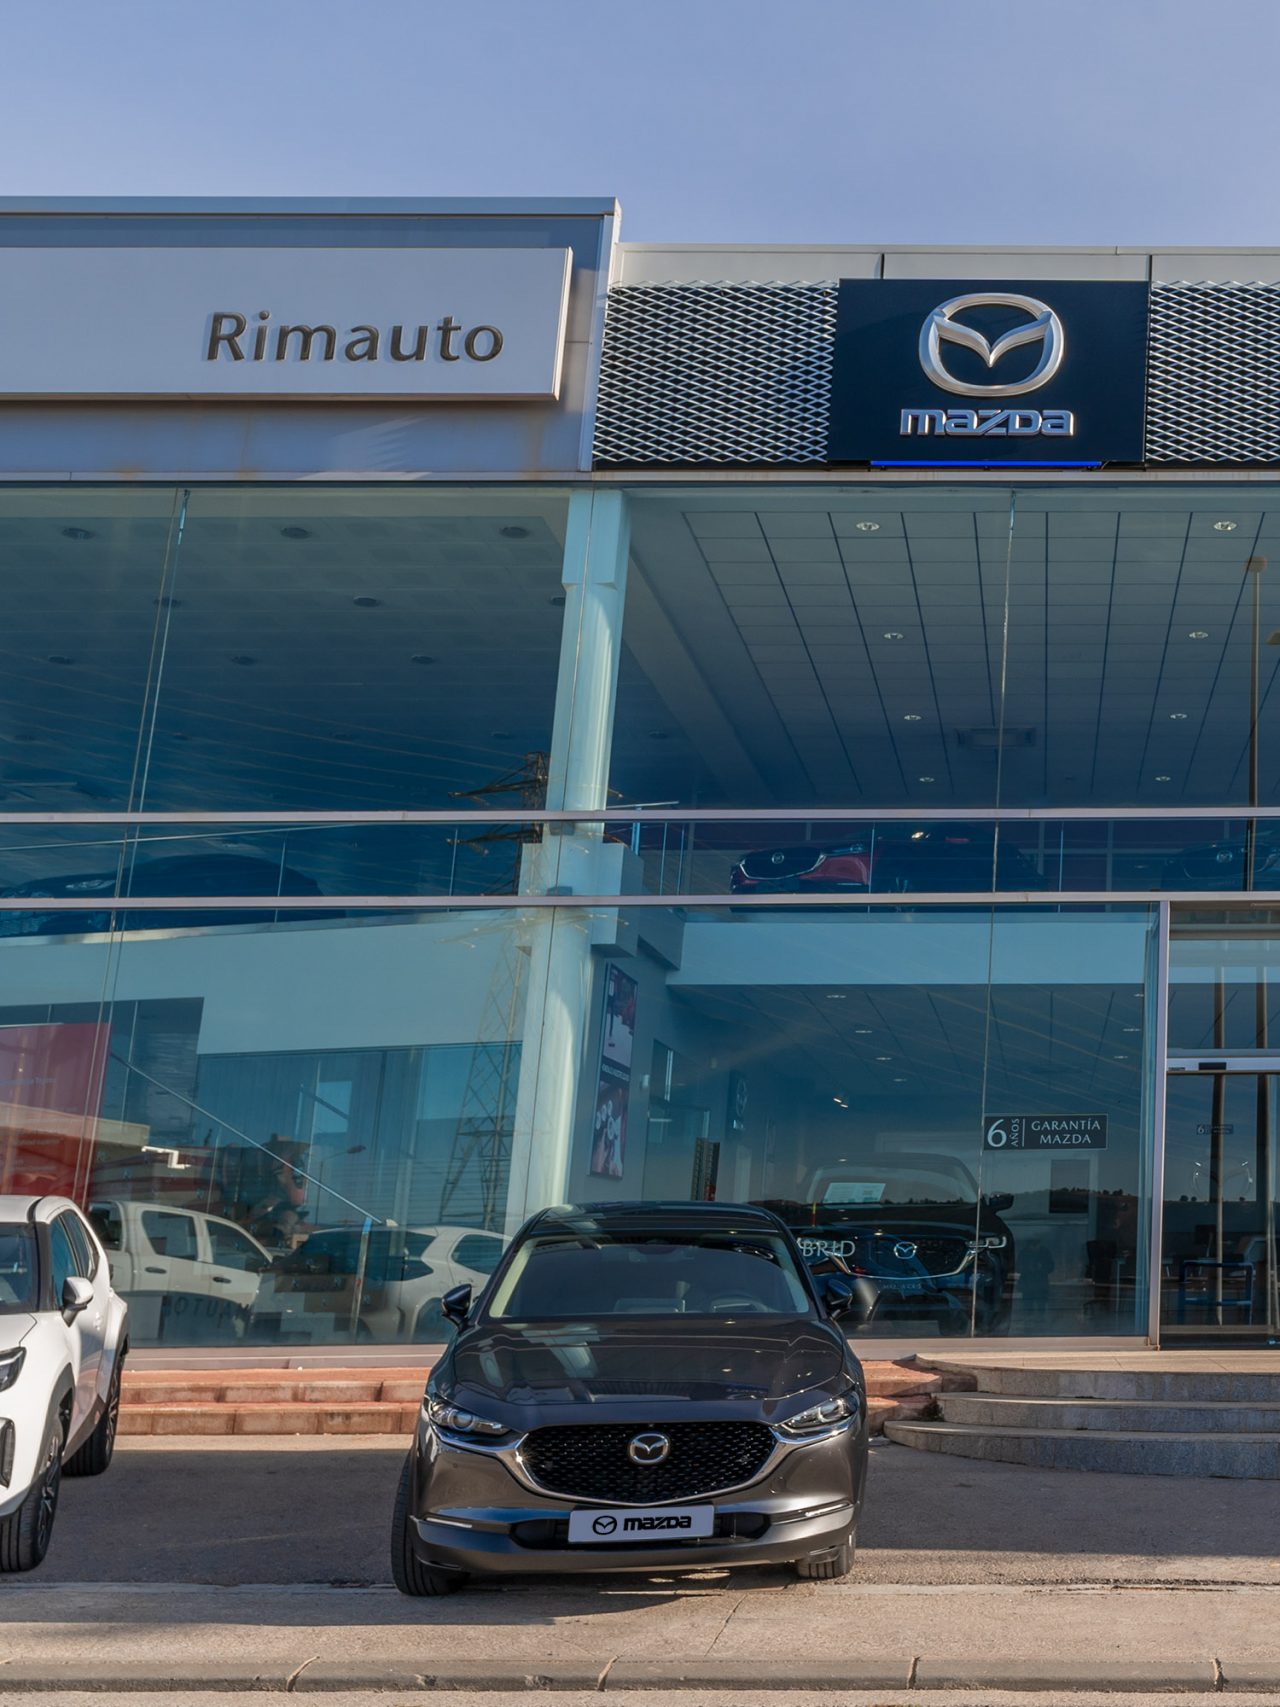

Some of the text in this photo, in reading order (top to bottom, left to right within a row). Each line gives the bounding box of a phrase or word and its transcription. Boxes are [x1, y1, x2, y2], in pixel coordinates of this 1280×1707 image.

[206, 310, 504, 361] Rimauto
[900, 409, 1074, 436] mazda
[987, 1119, 1007, 1147] 6
[1009, 1118, 1020, 1147] AÑOS
[1031, 1118, 1100, 1130] GARANTÍA
[1040, 1134, 1092, 1145] MAZDA
[803, 1241, 856, 1257] BRID
[624, 1516, 691, 1531] mazda
